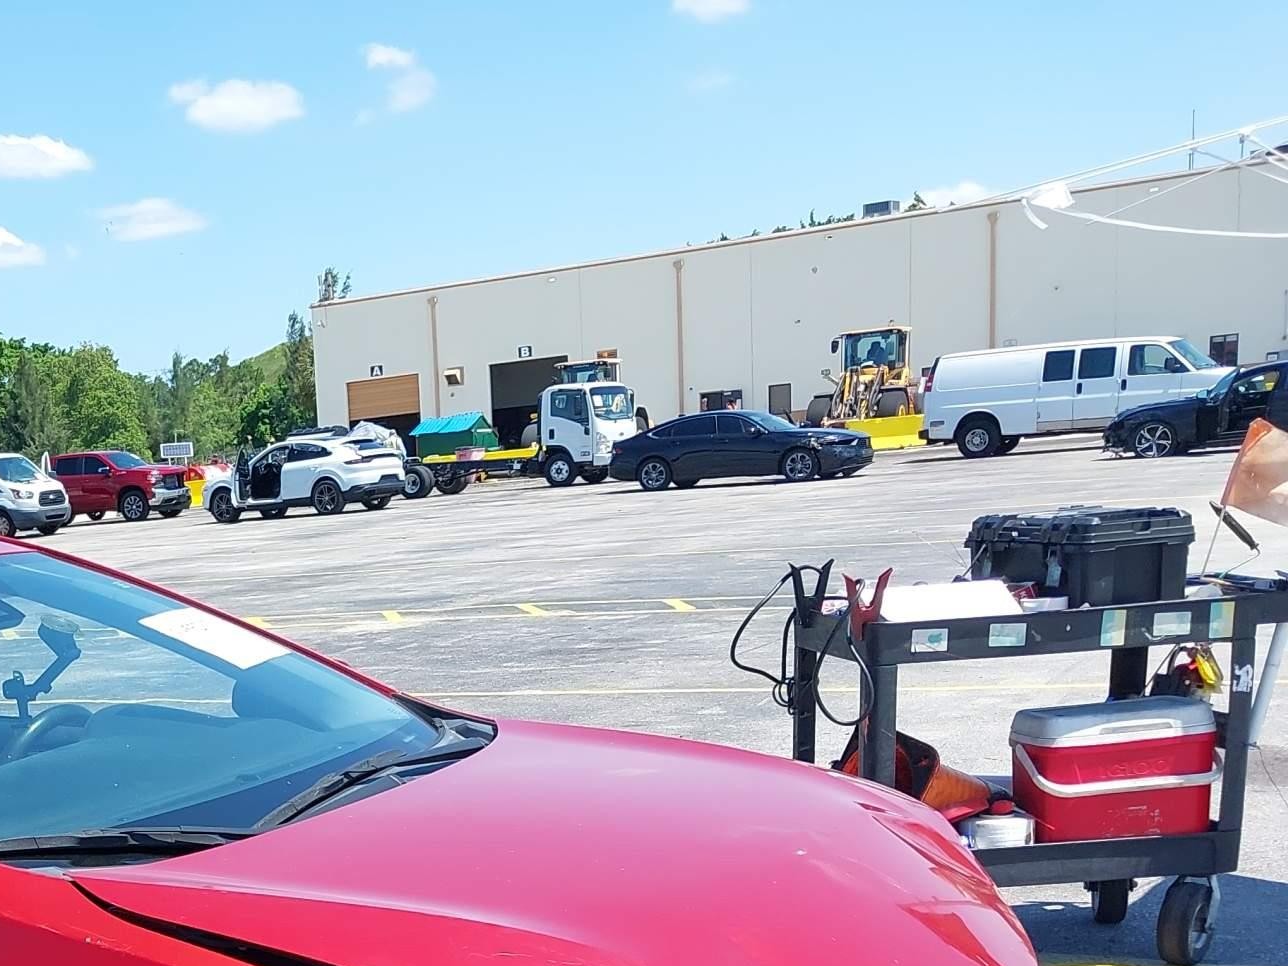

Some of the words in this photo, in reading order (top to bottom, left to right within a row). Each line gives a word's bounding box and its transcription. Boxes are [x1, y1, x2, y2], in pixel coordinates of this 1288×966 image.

[520, 346, 530, 357] B
[372, 366, 381, 377] A
[1098, 760, 1170, 778] IGLOO
